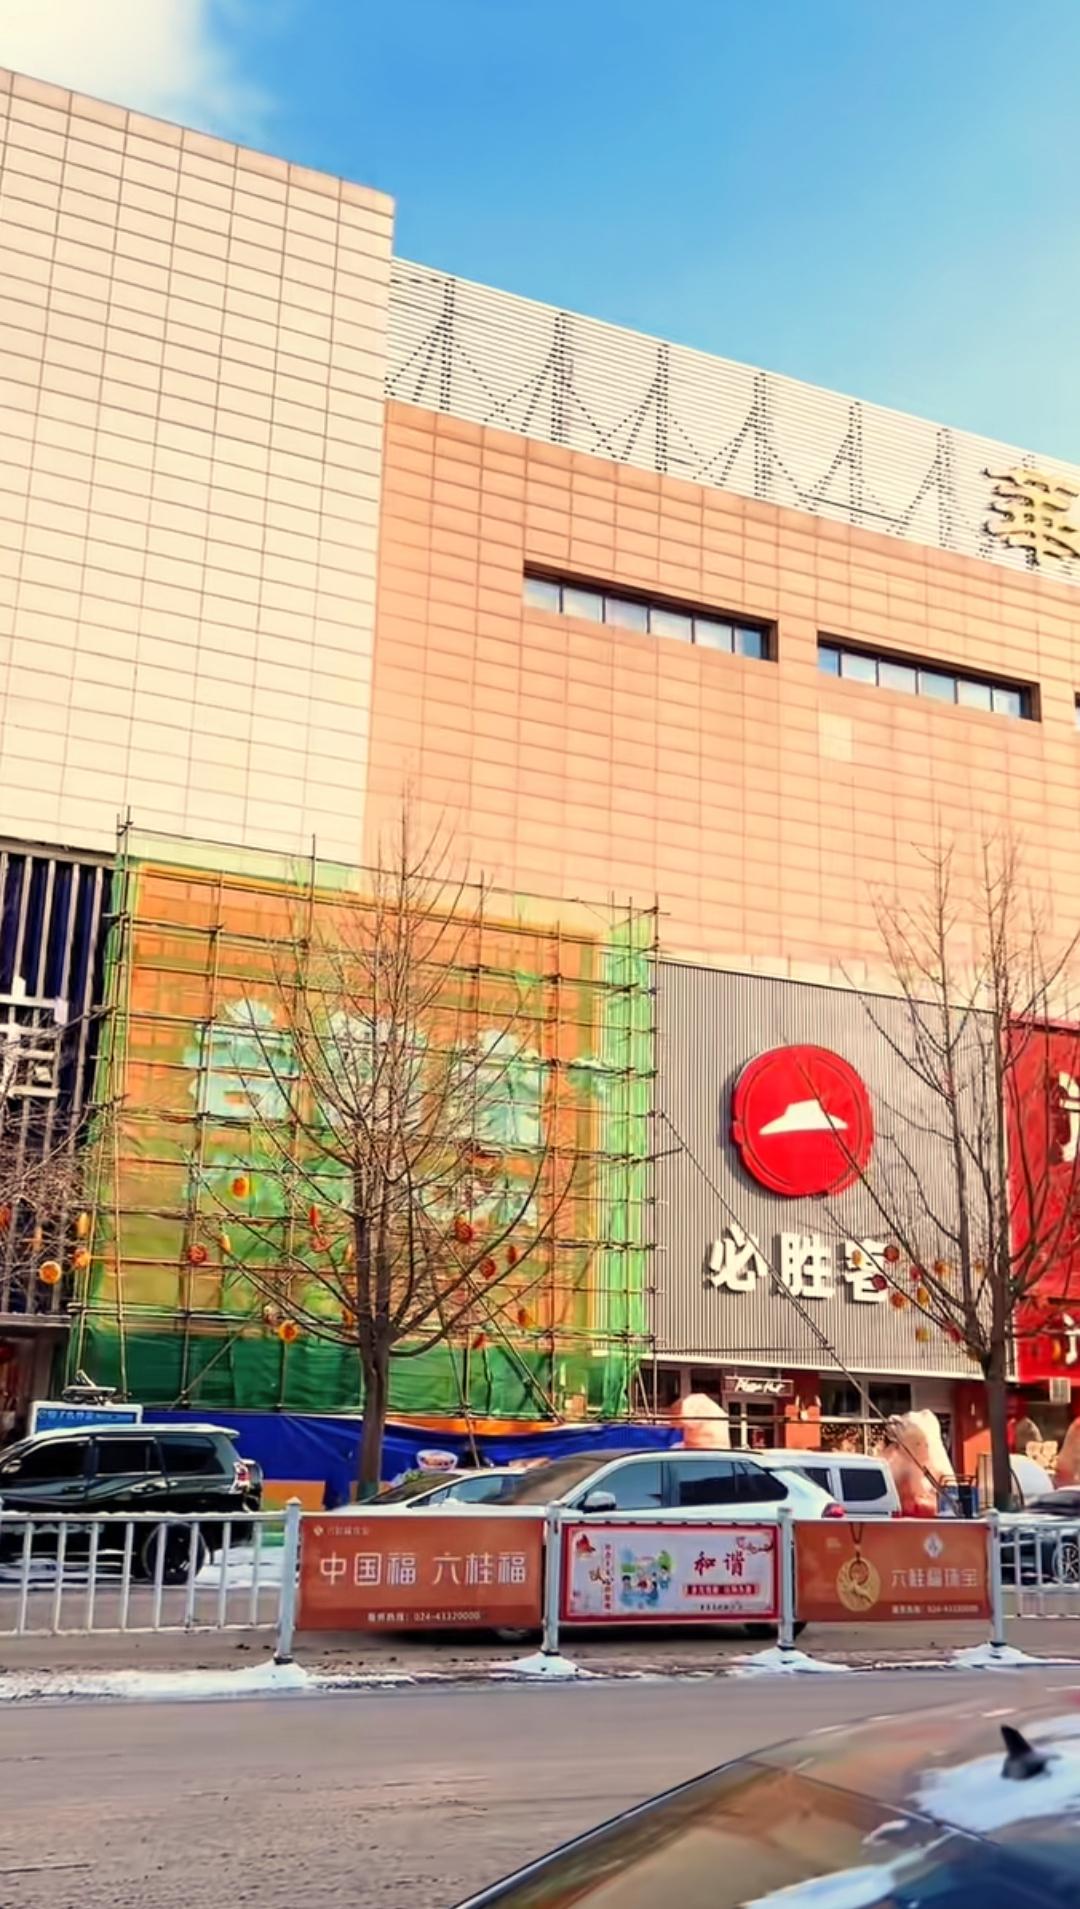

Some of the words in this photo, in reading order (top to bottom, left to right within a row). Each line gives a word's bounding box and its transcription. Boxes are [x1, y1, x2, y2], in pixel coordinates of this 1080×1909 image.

[708, 1222, 892, 1303] 必胜客
[320, 1551, 417, 1586] 中国福
[432, 1551, 527, 1585] 六桂福
[694, 1551, 745, 1577] 和谐
